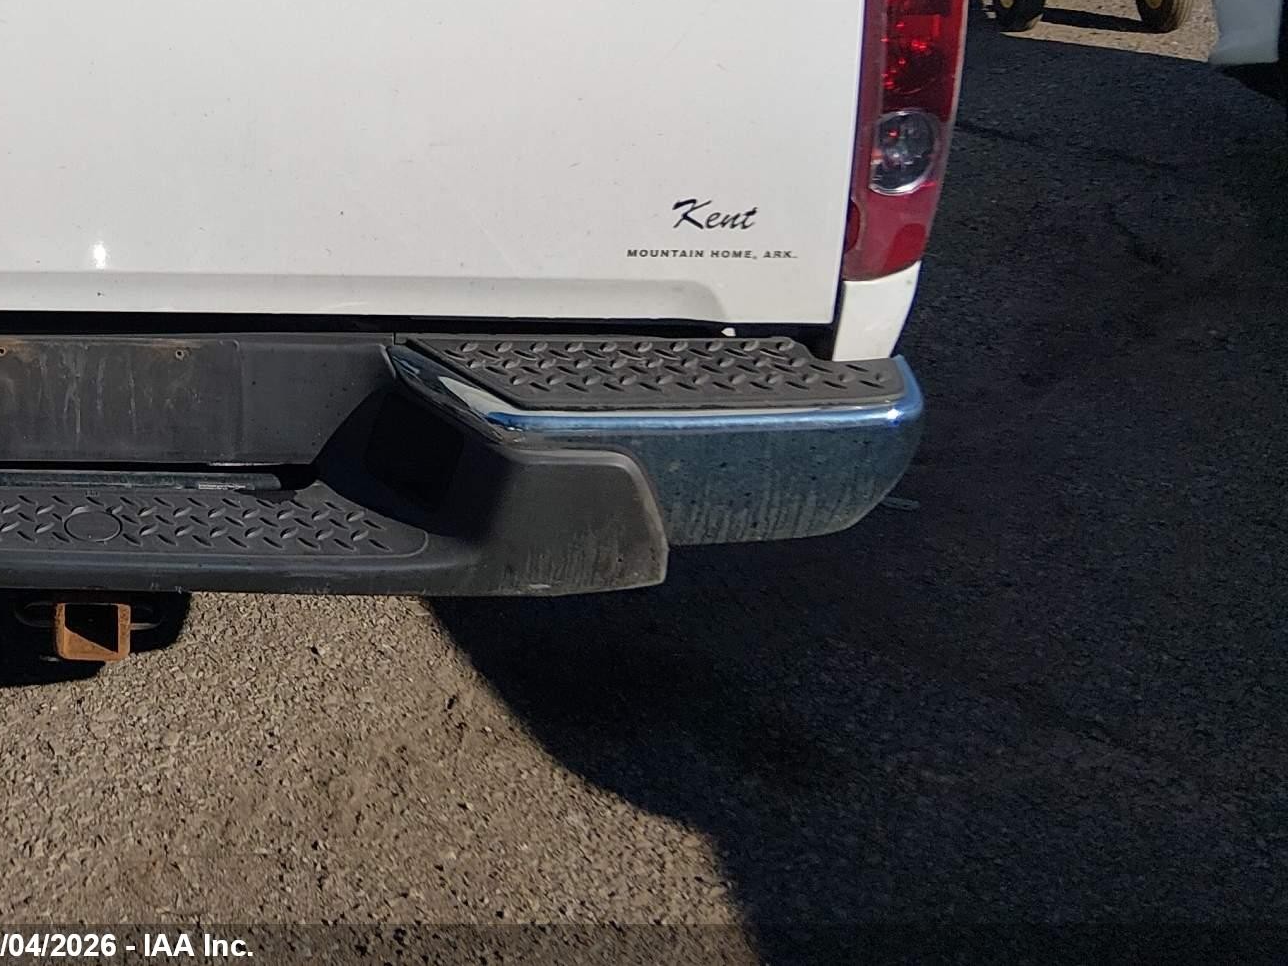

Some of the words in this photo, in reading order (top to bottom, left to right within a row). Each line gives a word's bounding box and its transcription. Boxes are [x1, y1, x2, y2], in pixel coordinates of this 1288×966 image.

[672, 198, 758, 230] Kent
[626, 249, 704, 258] MOUNTAIN
[710, 250, 758, 260] HOME,
[763, 250, 799, 259] ARK.
